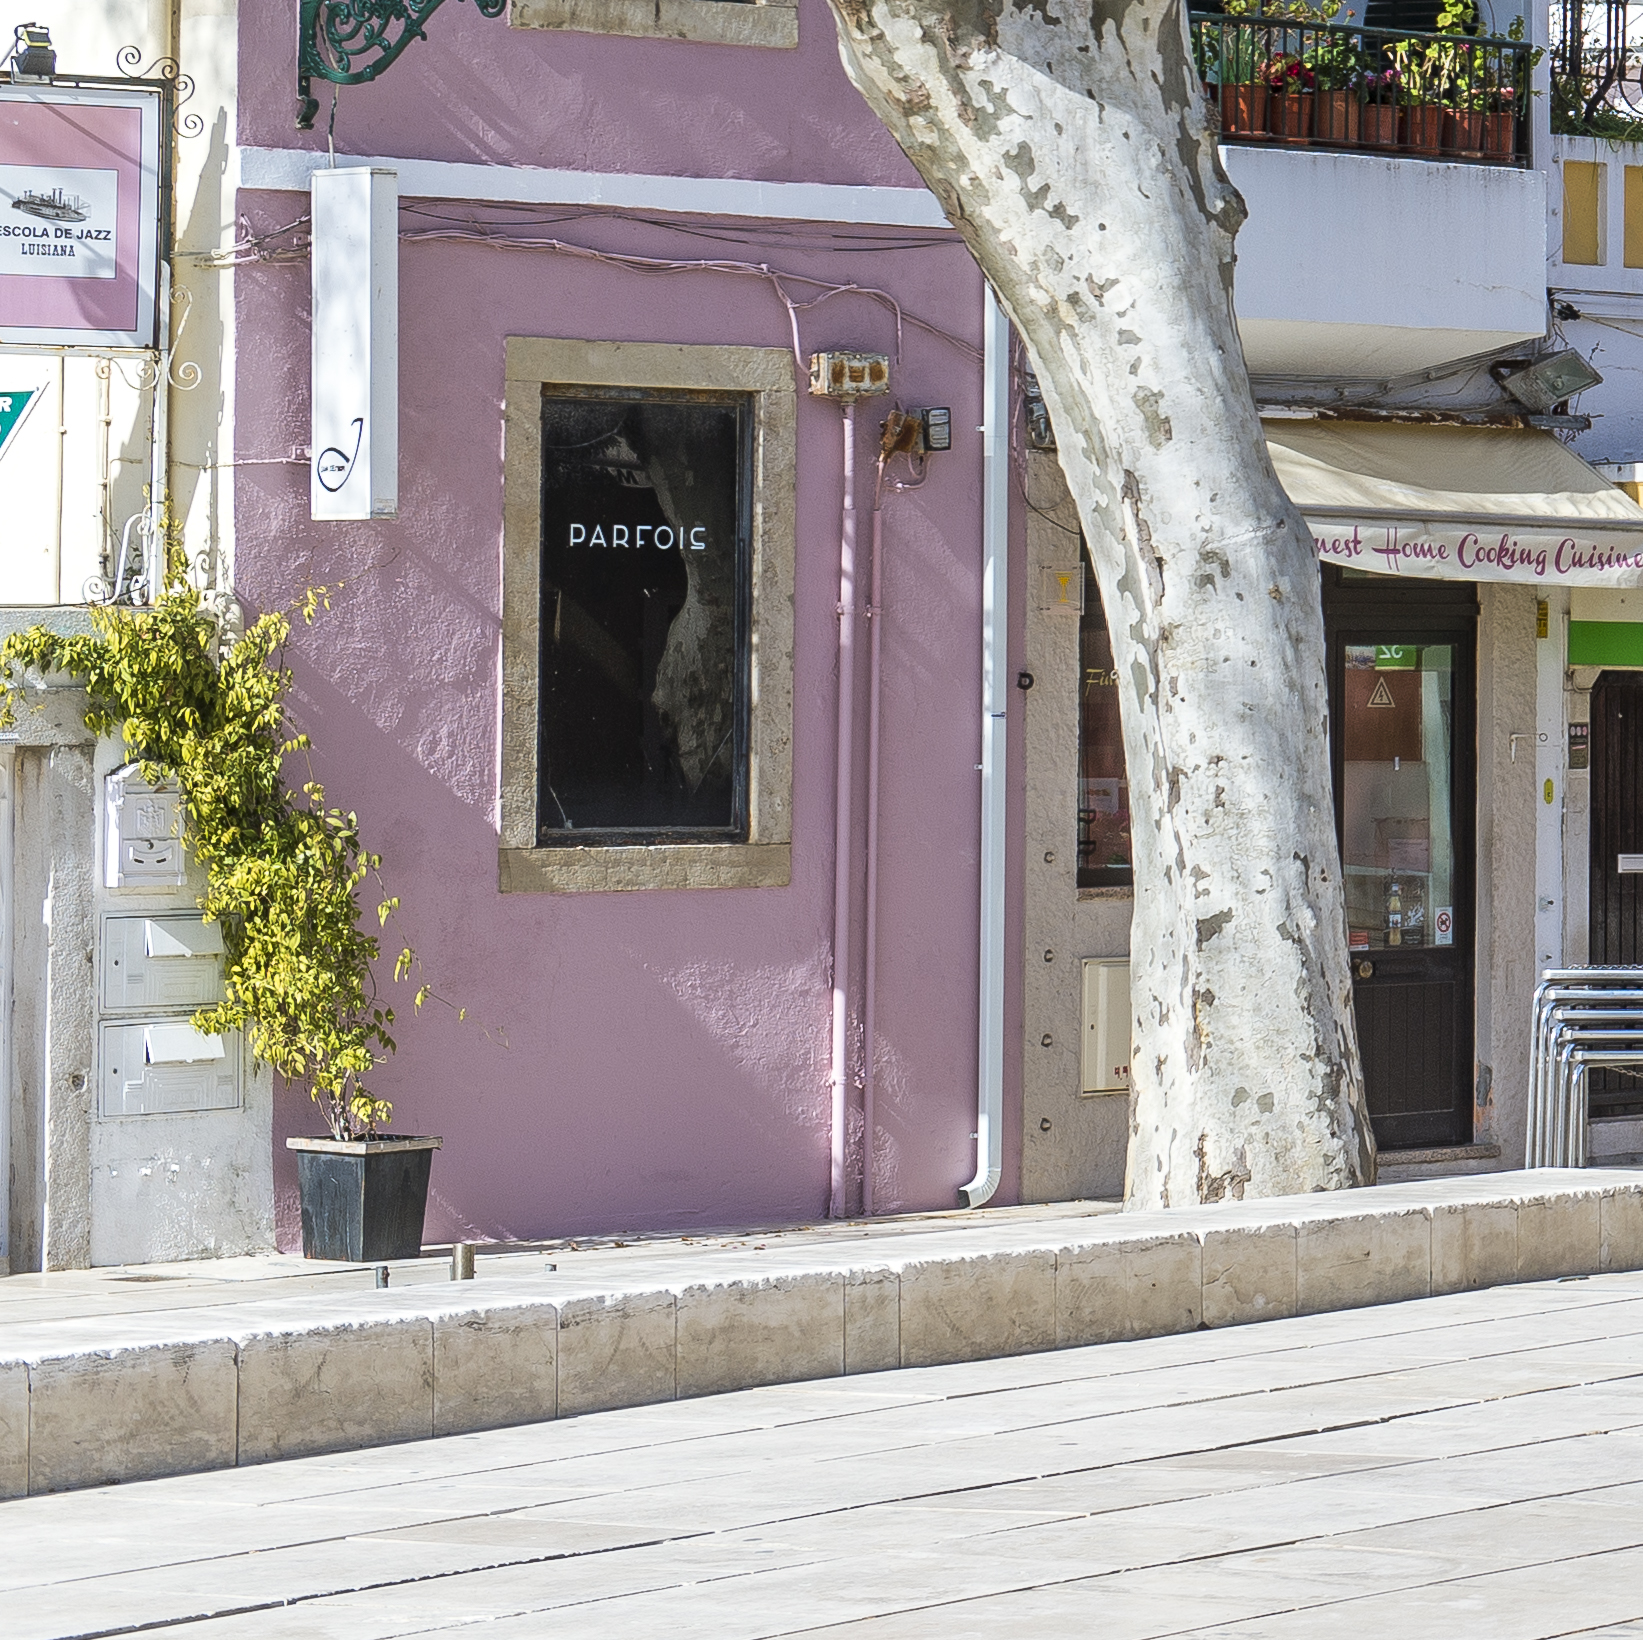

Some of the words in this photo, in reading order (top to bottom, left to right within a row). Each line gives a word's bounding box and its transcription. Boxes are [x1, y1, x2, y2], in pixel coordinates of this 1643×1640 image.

[0, 226, 50, 239] SCOLA
[54, 227, 73, 239] DE
[76, 228, 111, 241] JAZZ
[21, 242, 76, 257] LUISIANA
[569, 523, 706, 550] PARFOIS
[1314, 524, 1363, 558] nest
[1371, 526, 1450, 572] Home
[1457, 533, 1548, 576] Cooking
